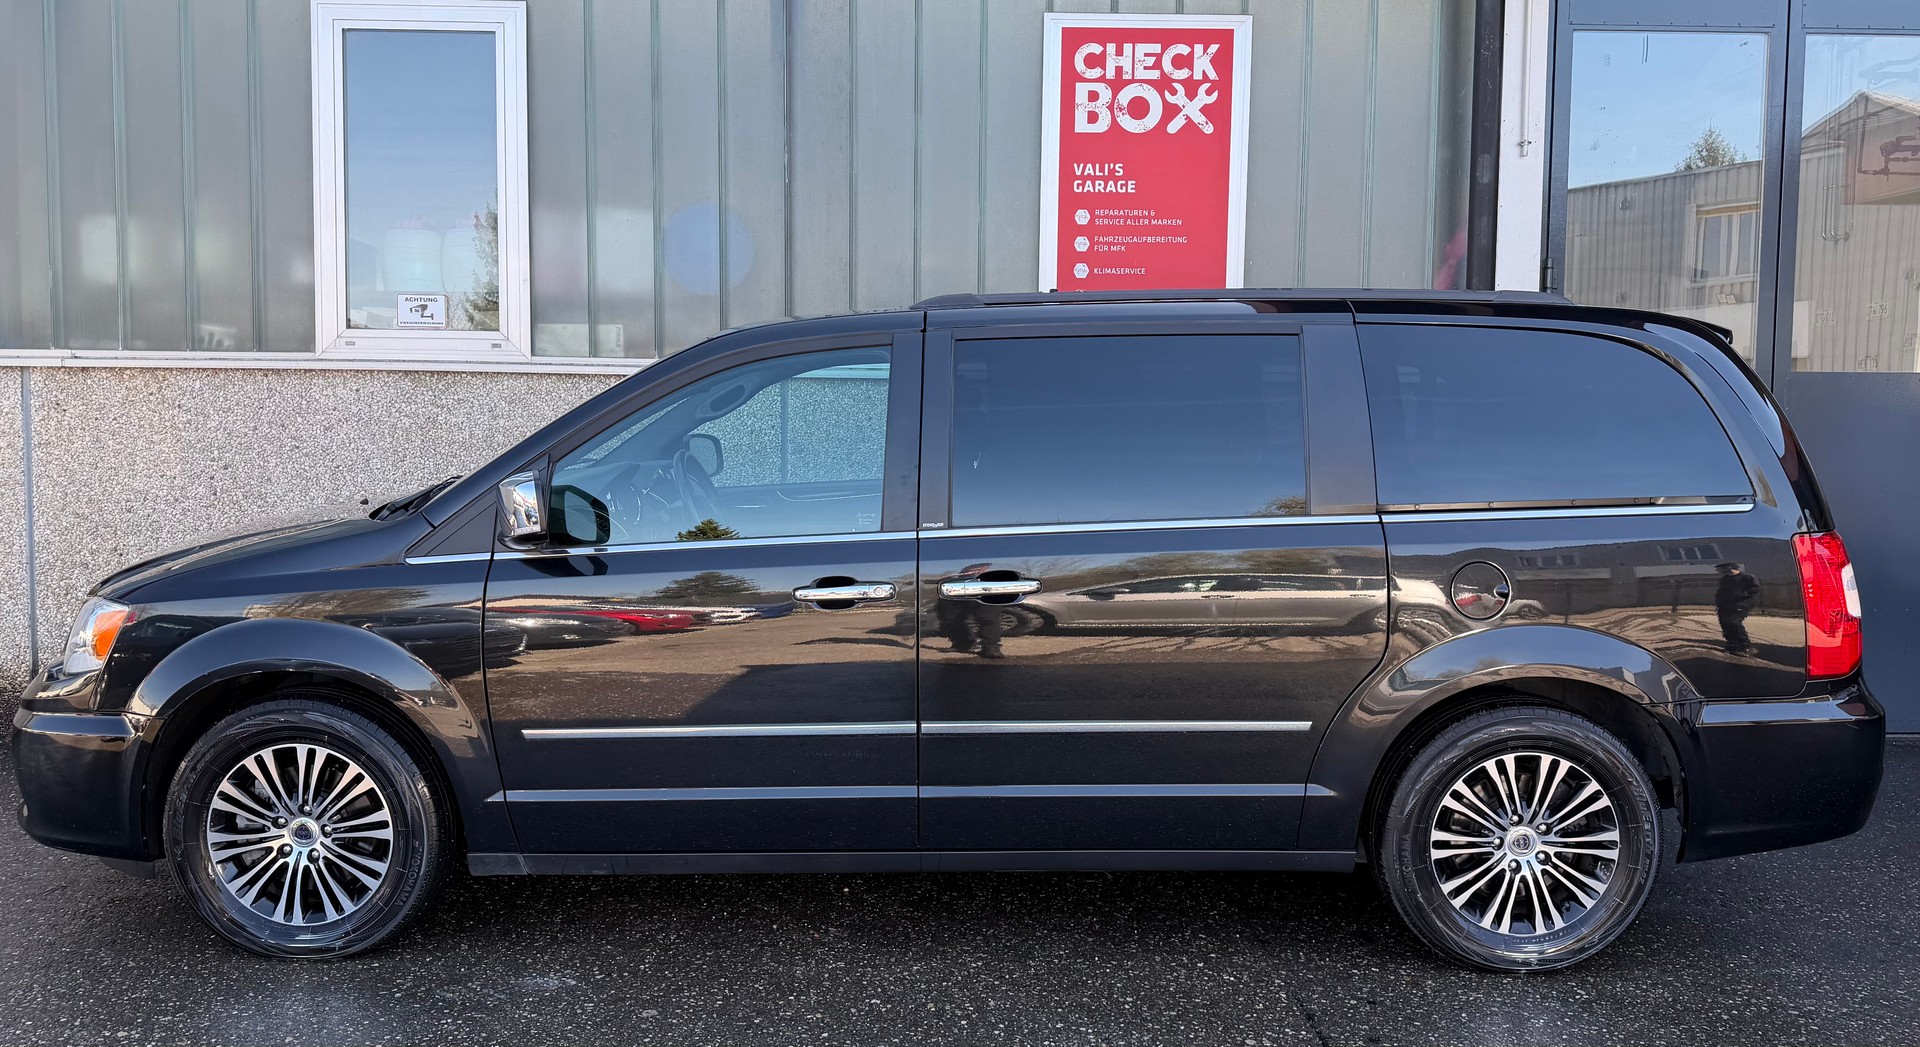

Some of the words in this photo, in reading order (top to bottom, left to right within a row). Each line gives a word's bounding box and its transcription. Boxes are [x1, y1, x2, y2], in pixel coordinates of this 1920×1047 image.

[1073, 42, 1220, 81] CHECK
[1073, 82, 1219, 135] BOX
[1073, 162, 1124, 177] VALI'S
[1073, 179, 1136, 194] GARAGE
[1094, 209, 1149, 217] REPARATUREN
[1150, 209, 1156, 217] &
[1094, 218, 1125, 226] SERVICE
[1126, 218, 1149, 226] ALLER
[1151, 218, 1183, 226] MARKEN
[1094, 235, 1188, 243] FAHRZEUGAUFBEREITUNG
[1094, 243, 1109, 252] FÜR
[1110, 244, 1126, 252] MFK
[1093, 267, 1146, 275] KLIMASERVICE
[1399, 831, 1416, 892] YOKOHAMA
[392, 851, 424, 908] YOKOHAMA
